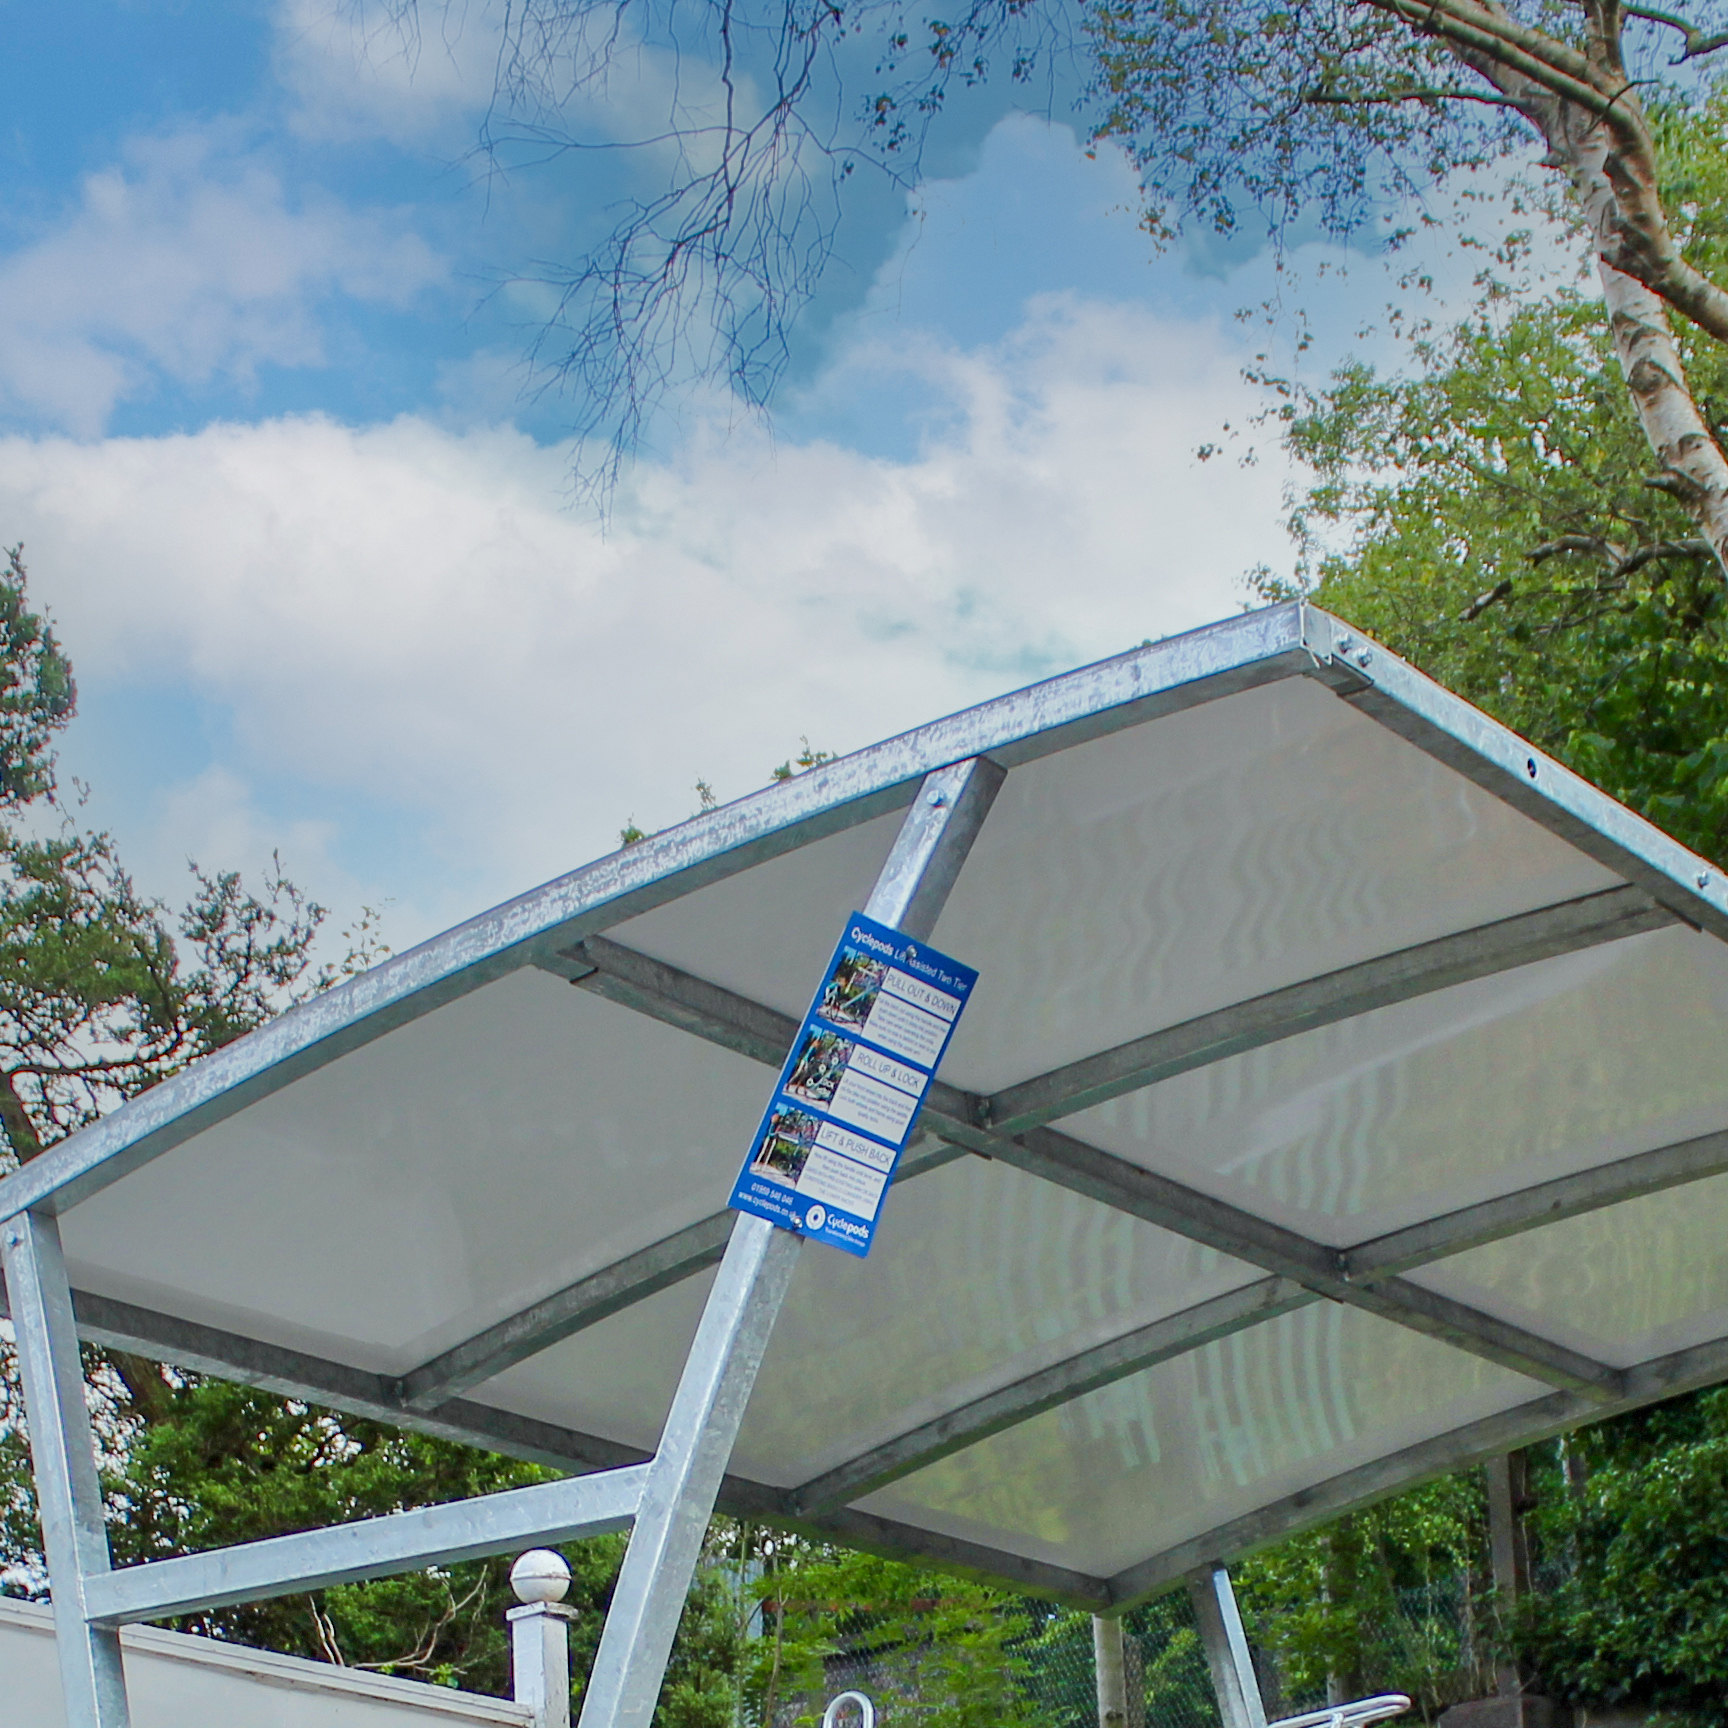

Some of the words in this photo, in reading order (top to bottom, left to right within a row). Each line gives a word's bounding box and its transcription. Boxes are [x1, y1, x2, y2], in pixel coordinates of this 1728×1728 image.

[851, 925, 895, 956] Cyclepods
[938, 970, 952, 985] Two
[952, 977, 967, 992] Tier
[886, 974, 908, 991] PULL
[907, 983, 926, 1000] OUT
[924, 992, 932, 1003] &
[931, 995, 957, 1015] DOWN
[857, 1052, 879, 1070] ROLL
[879, 1062, 892, 1075] UP
[891, 1068, 898, 1078] &
[898, 1071, 920, 1088] LOCK
[820, 1128, 839, 1143] LIFT
[838, 1136, 846, 1146] &
[846, 1139, 869, 1156] PUSH
[869, 1148, 892, 1166] BACK
[826, 1211, 870, 1238] Cyclepods
